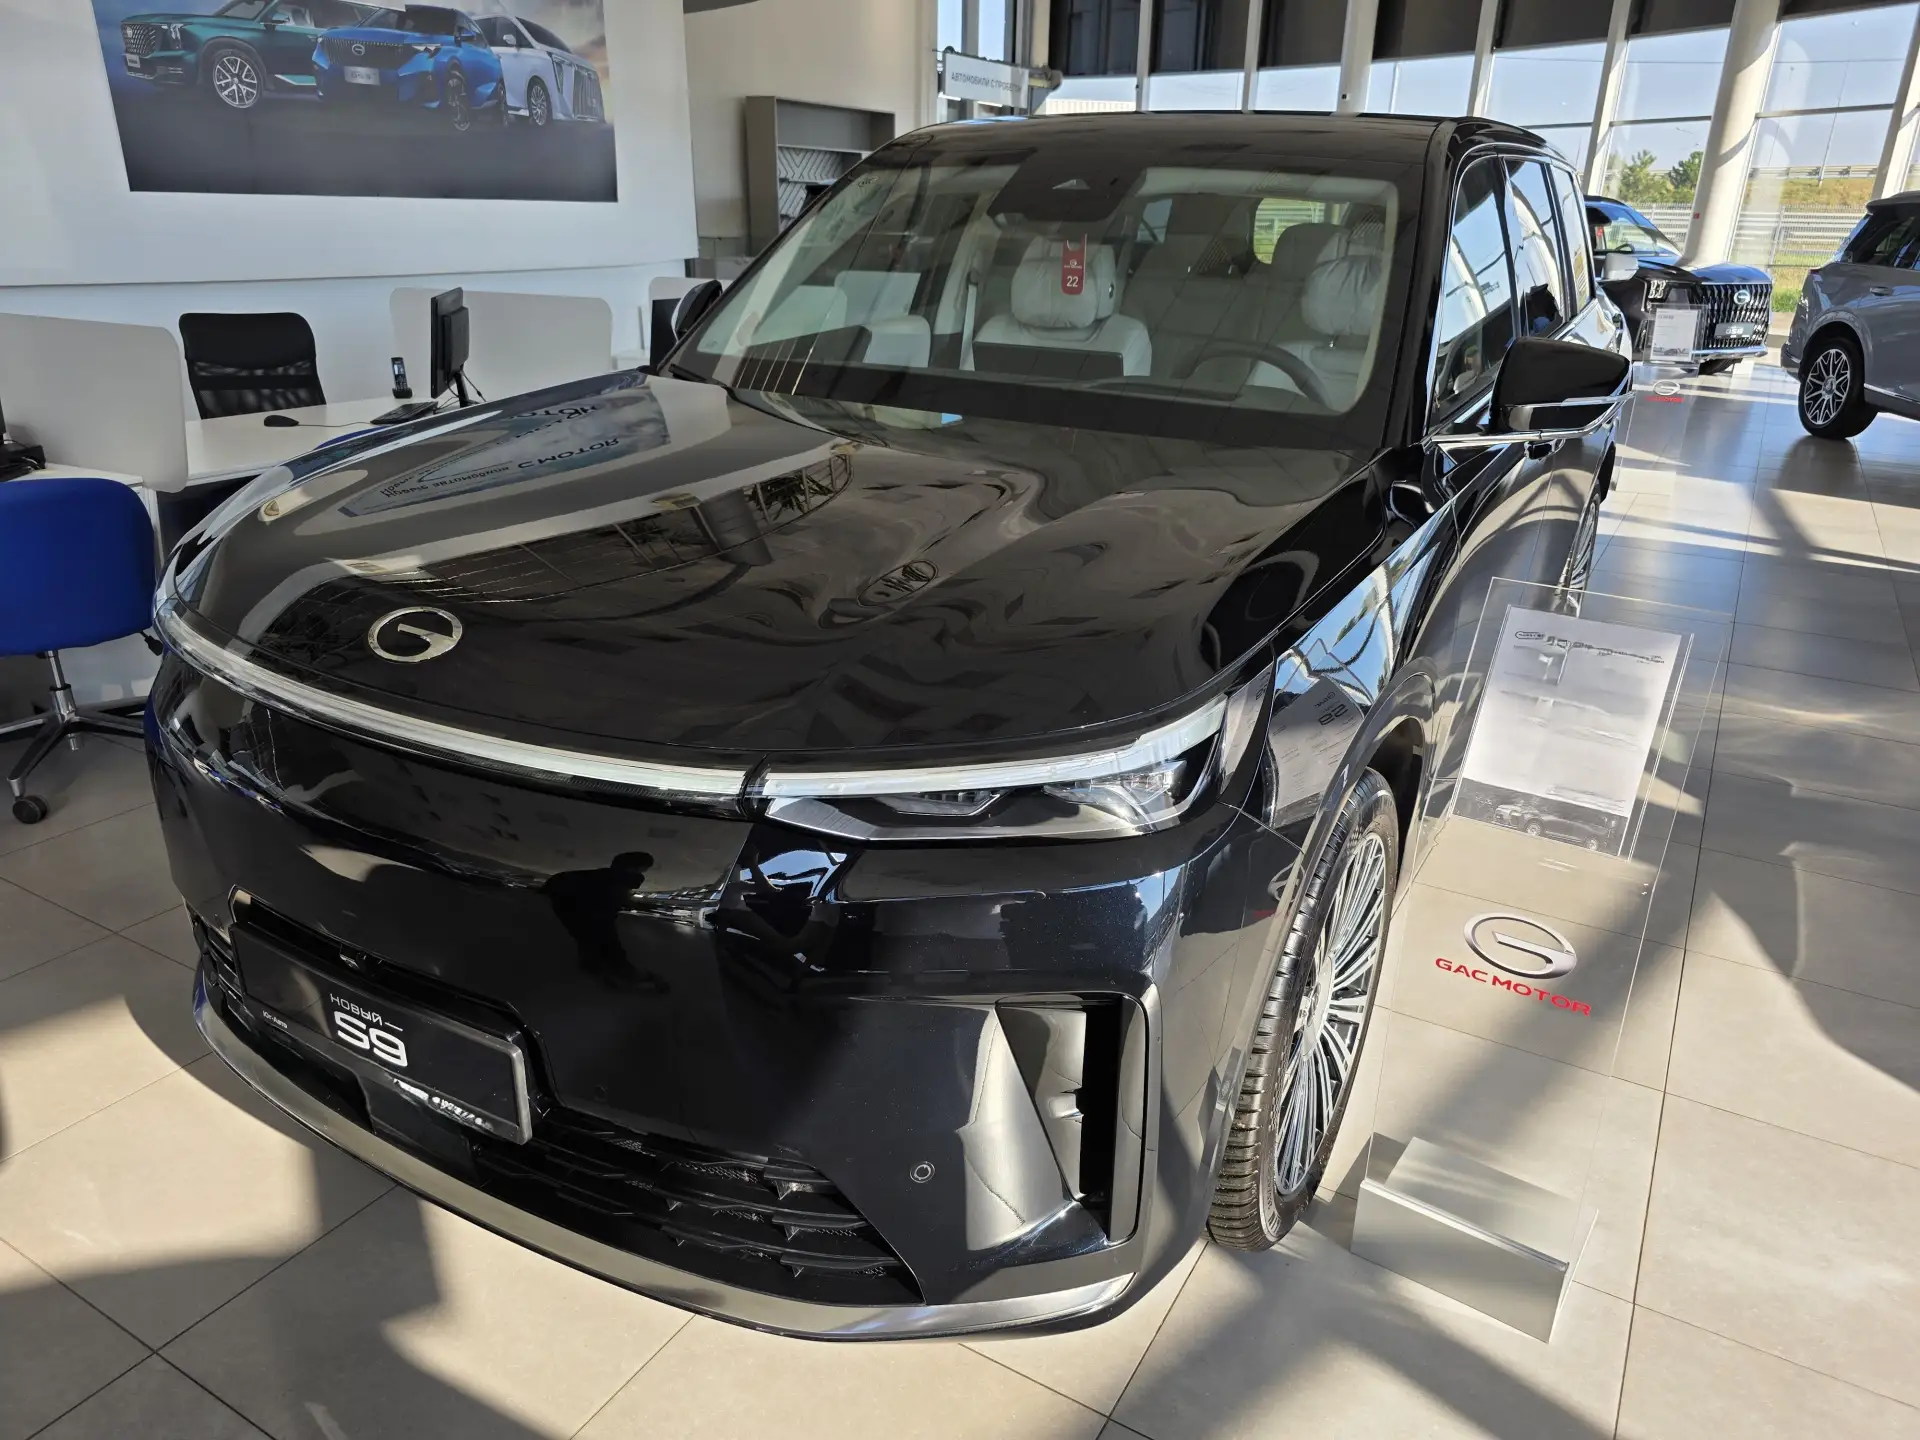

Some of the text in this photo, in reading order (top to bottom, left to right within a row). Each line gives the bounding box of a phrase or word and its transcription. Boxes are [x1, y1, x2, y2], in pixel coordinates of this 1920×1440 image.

[951, 72, 990, 89] АВТОМОБИЛИ
[1066, 275, 1079, 288] 22
[1435, 957, 1592, 1017] GAC MOTOR
[333, 1010, 408, 1067] S9
